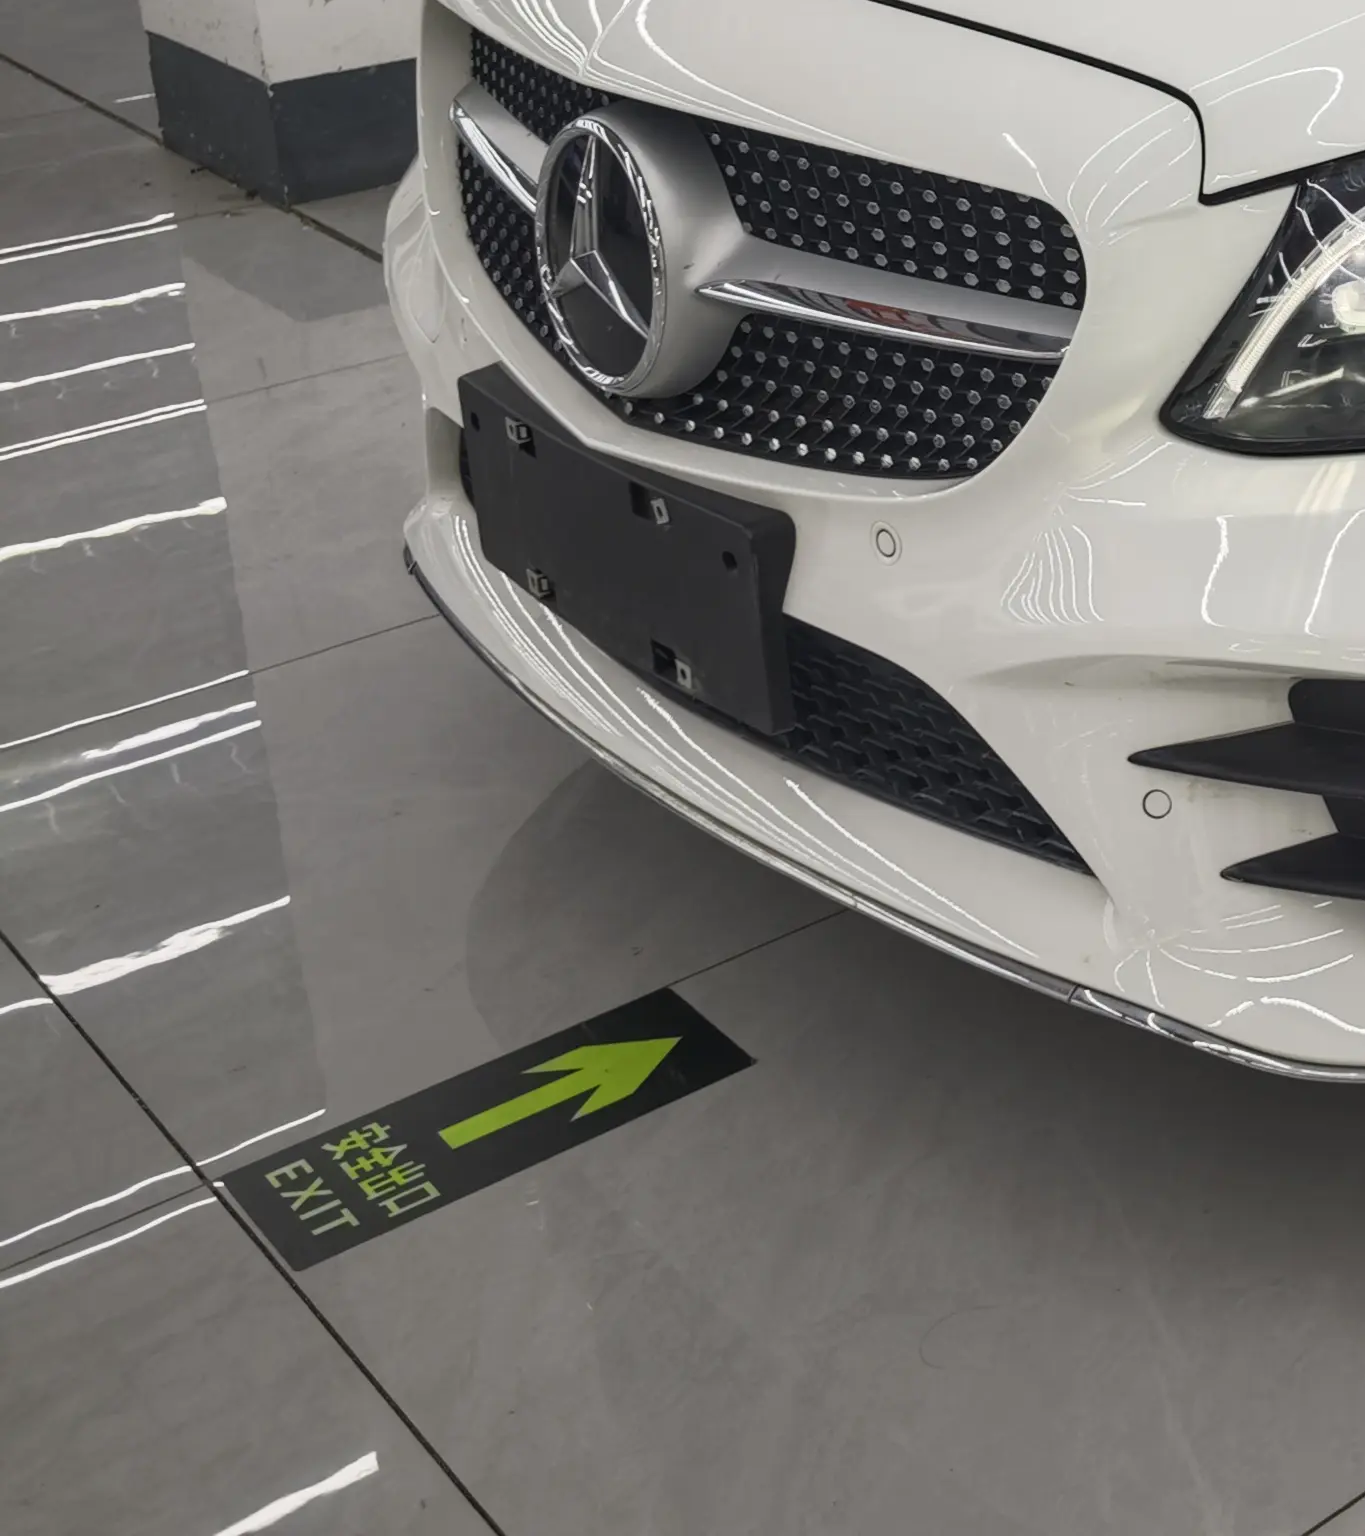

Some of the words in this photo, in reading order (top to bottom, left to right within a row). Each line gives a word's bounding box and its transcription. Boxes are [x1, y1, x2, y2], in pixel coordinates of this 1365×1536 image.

[264, 1158, 361, 1236] EXIT
[321, 1122, 441, 1218] 安全出口
